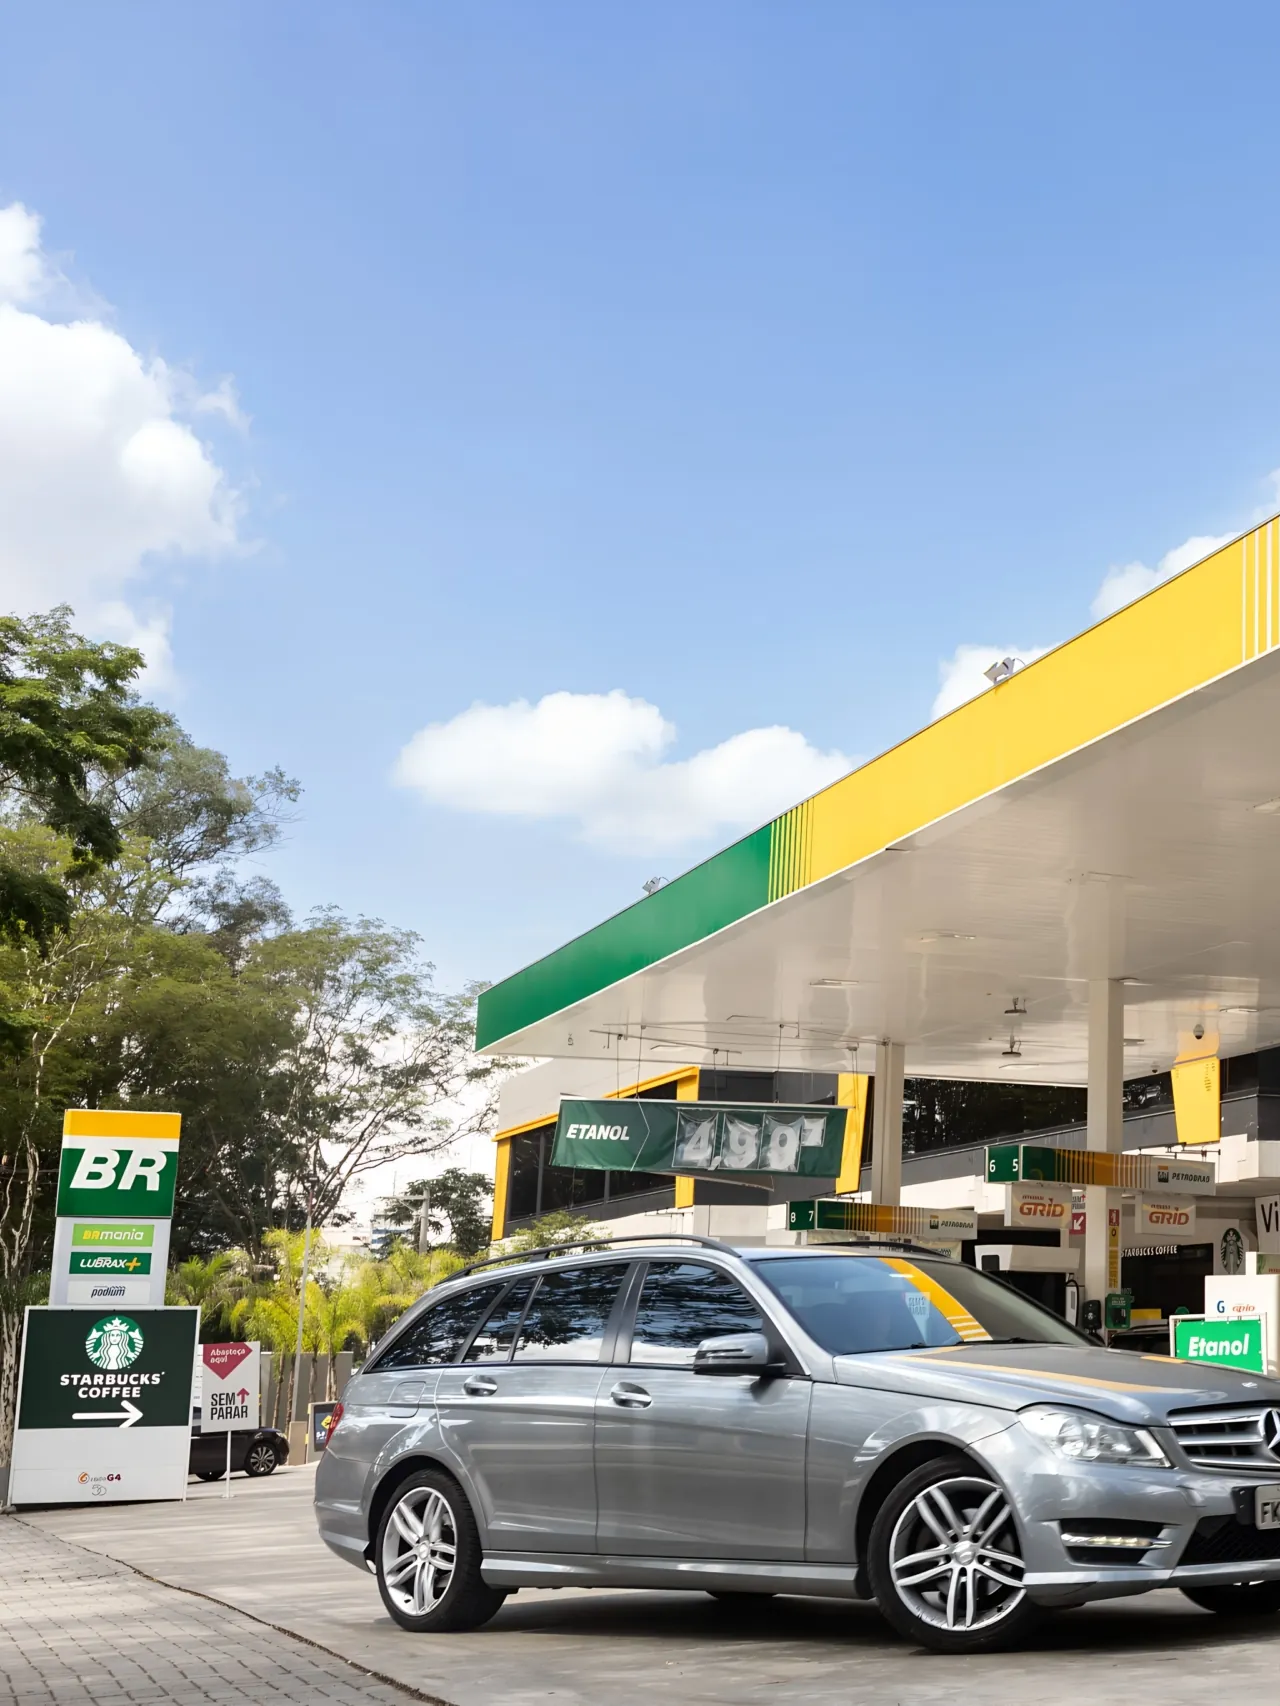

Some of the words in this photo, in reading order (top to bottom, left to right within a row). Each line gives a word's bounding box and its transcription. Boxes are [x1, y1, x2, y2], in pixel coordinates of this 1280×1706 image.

[565, 1123, 630, 1141] ETANOL
[70, 1148, 167, 1191] BR
[990, 1159, 996, 1173] 6
[1012, 1158, 1019, 1172] 5
[1019, 1198, 1065, 1218] GRID
[790, 1211, 796, 1223] 8
[808, 1210, 814, 1222] 7
[1148, 1206, 1190, 1226] GRID
[1155, 1244, 1178, 1255] COFFEE
[90, 1286, 126, 1299] podium
[1216, 1300, 1226, 1314] G
[1188, 1333, 1250, 1357] Etanol
[60, 1373, 161, 1386] STARBUCKS
[78, 1386, 141, 1398] COFFEE
[210, 1392, 236, 1406] SEM
[210, 1405, 249, 1420] PARAR
